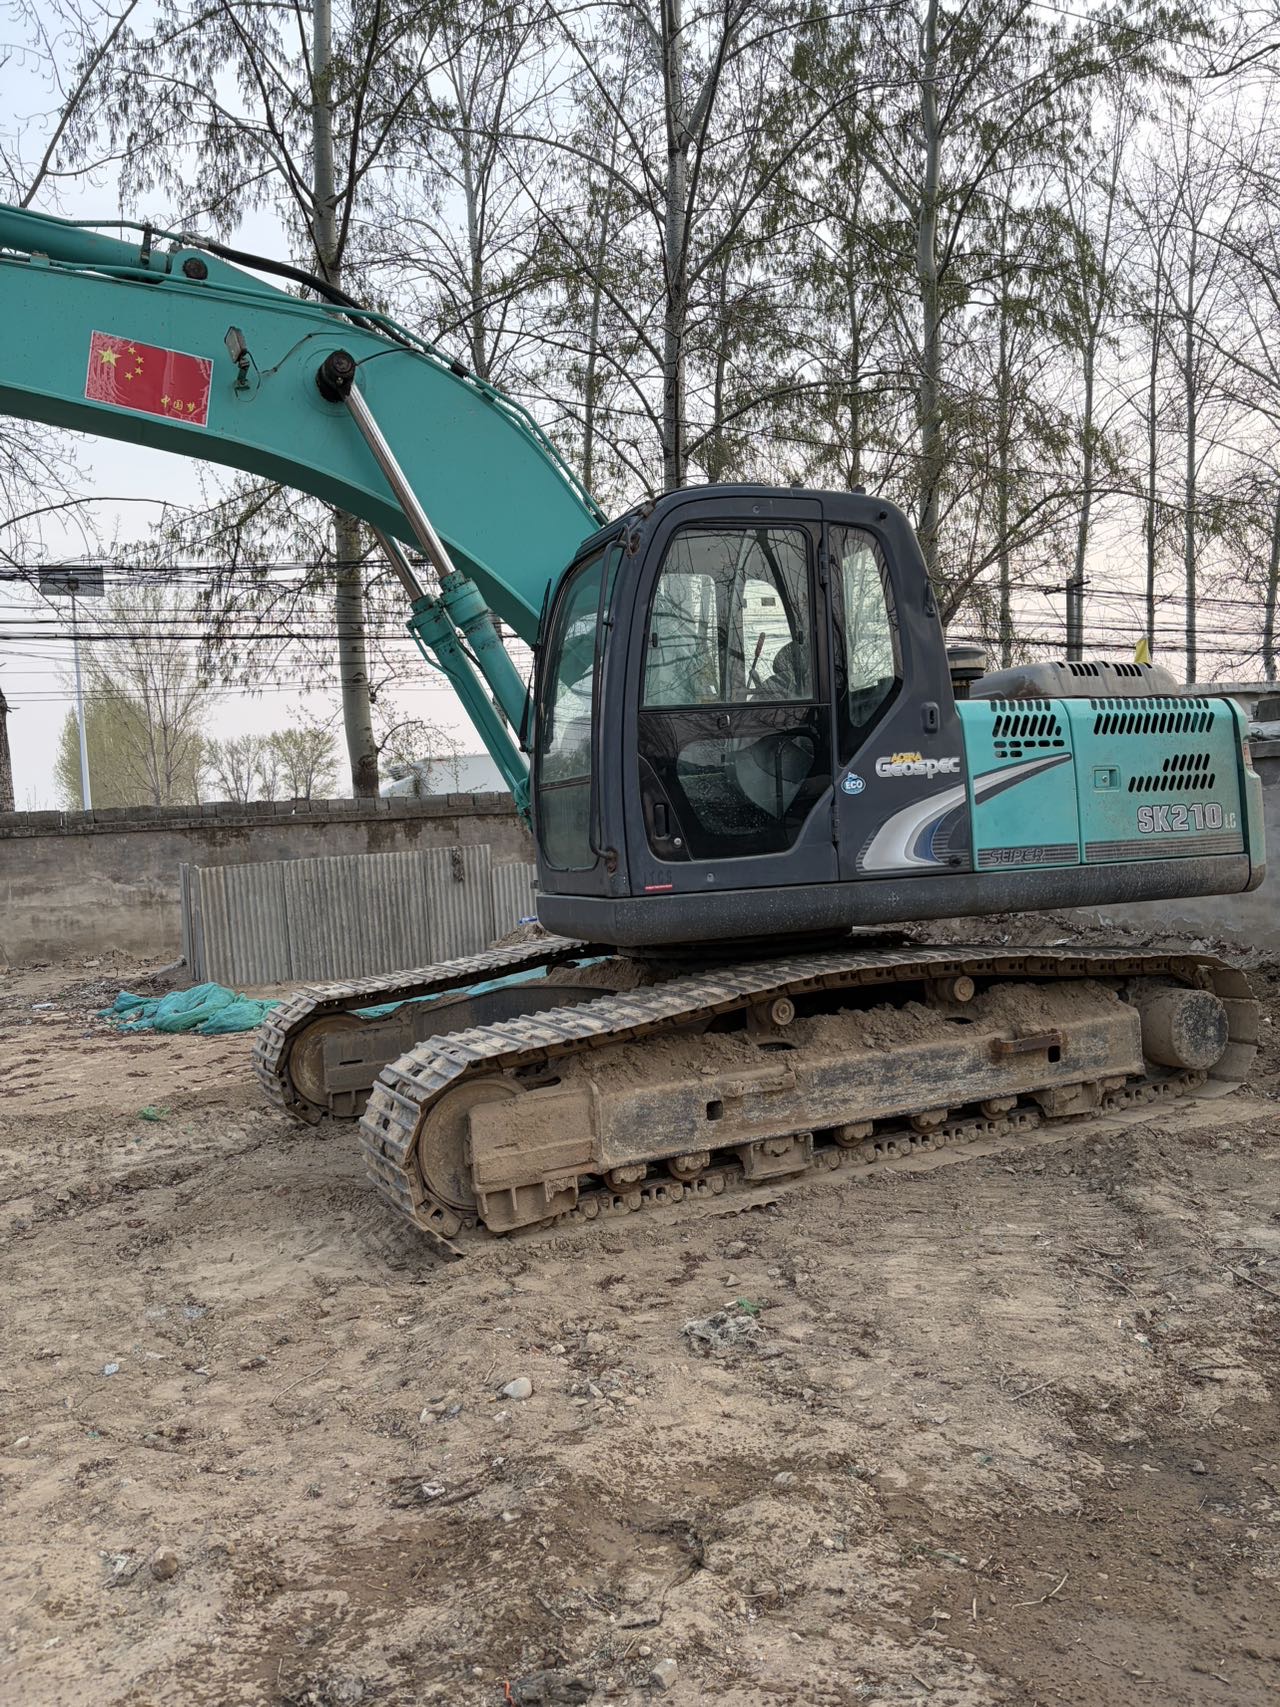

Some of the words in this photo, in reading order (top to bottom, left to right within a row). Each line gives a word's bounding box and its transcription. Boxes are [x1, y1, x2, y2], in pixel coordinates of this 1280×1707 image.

[161, 394, 196, 412] 中国梦
[845, 781, 863, 790] ECO
[1137, 802, 1223, 833] SK210
